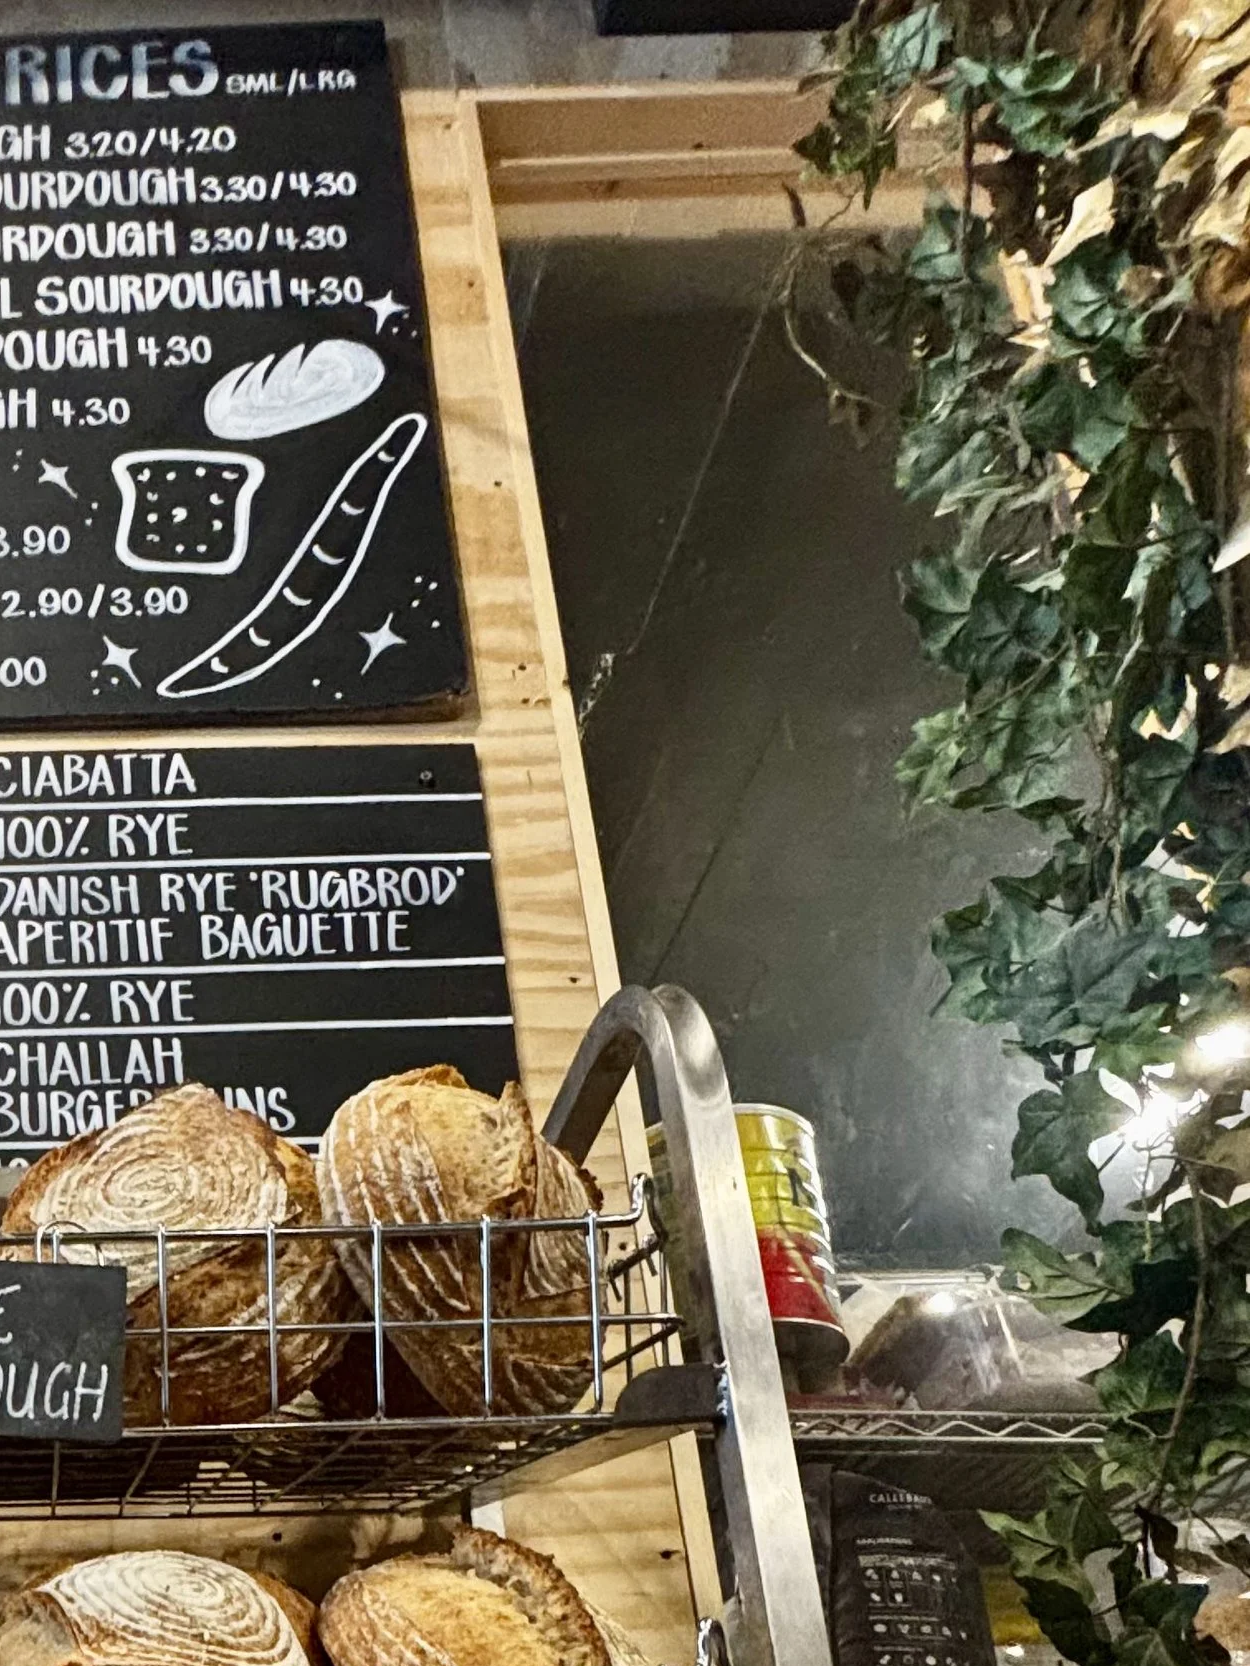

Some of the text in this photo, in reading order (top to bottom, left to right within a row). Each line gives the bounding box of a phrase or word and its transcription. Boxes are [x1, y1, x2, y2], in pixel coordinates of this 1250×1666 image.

[65, 126, 236, 158] 3.20/4.20
[200, 172, 356, 202] 3.30/4.30
[190, 222, 347, 253] 3.30/4.30
[35, 270, 282, 316] SOURDOUGH
[290, 277, 363, 306] 4.30
[138, 335, 211, 366] 4.30
[52, 398, 130, 426] 4.30
[2, 584, 188, 618] 2.90/3.90
[109, 813, 193, 857] RYE
[160, 873, 235, 912] RYE
[201, 911, 410, 959] BAGUETTE
[110, 980, 194, 1023] RYE
